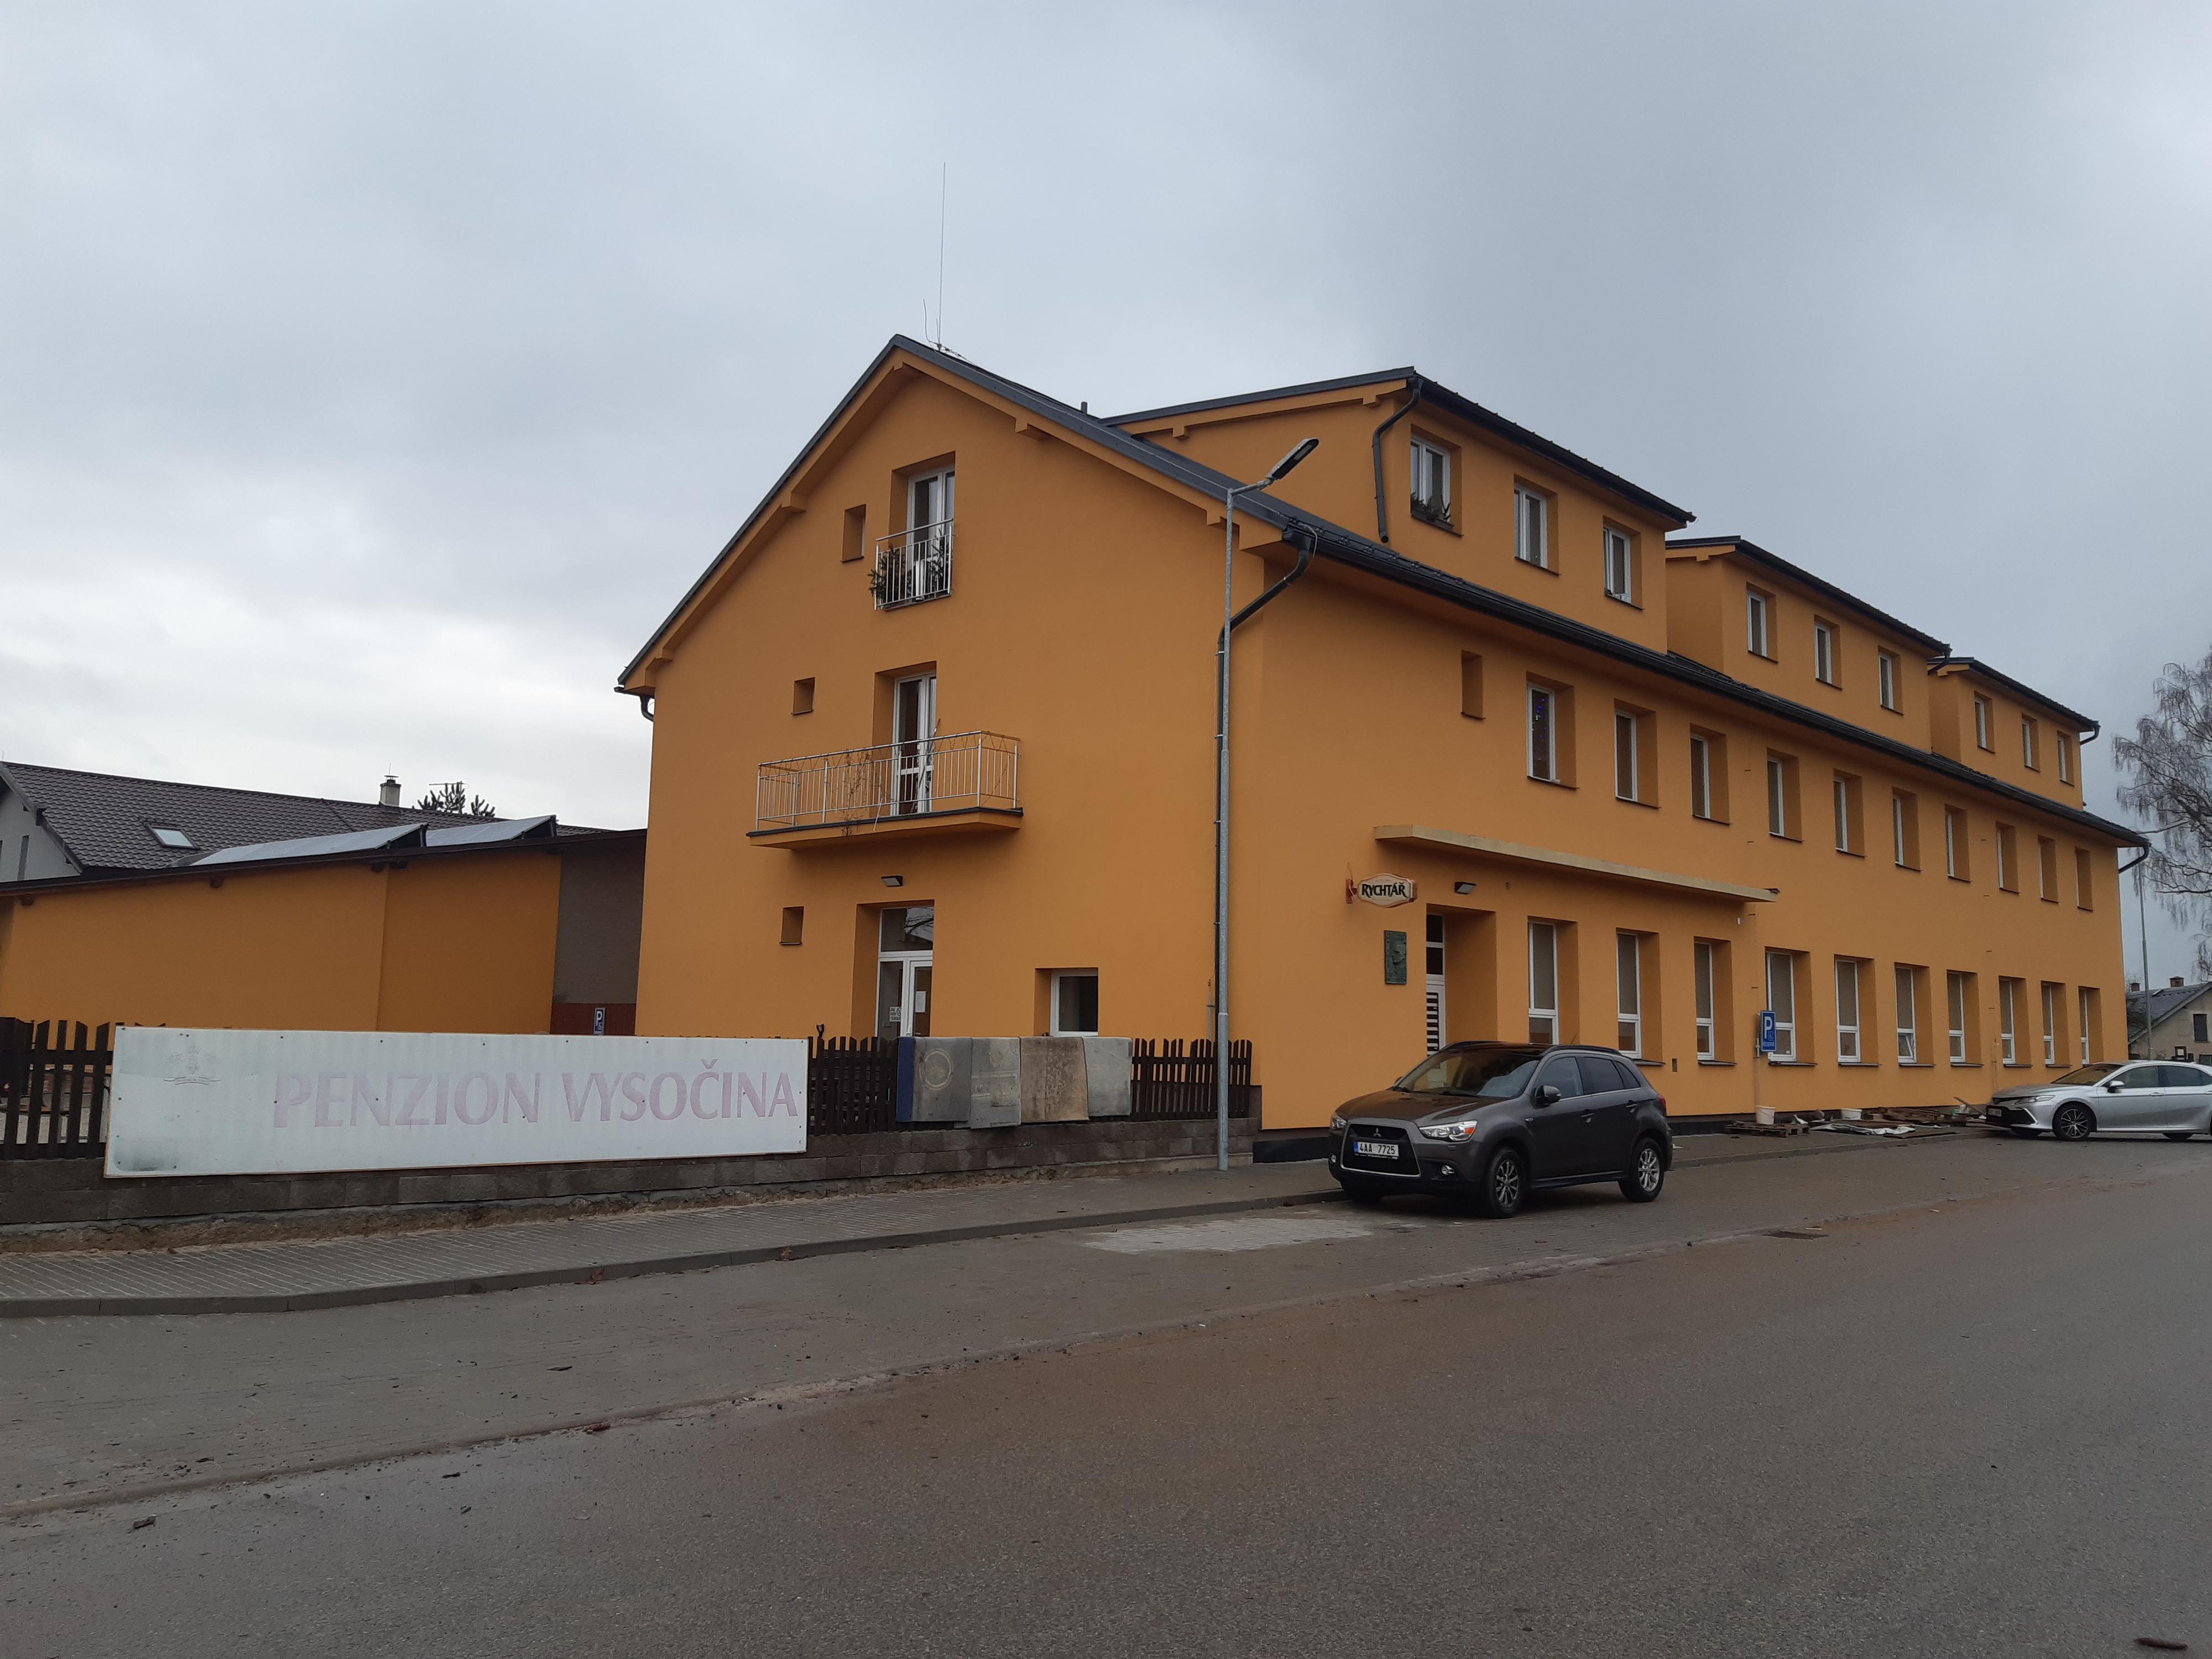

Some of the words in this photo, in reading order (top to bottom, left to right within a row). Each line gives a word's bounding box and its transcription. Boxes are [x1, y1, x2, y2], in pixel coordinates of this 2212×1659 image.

[1361, 882, 1408, 898] RYCHTÁŘ
[596, 1011, 602, 1026] P
[1765, 1016, 1772, 1039] P
[274, 1072, 540, 1128] PENZION
[561, 1058, 799, 1122] VYSOČINA
[1360, 1144, 1372, 1152] 4AA
[1378, 1145, 1395, 1154] 7725
